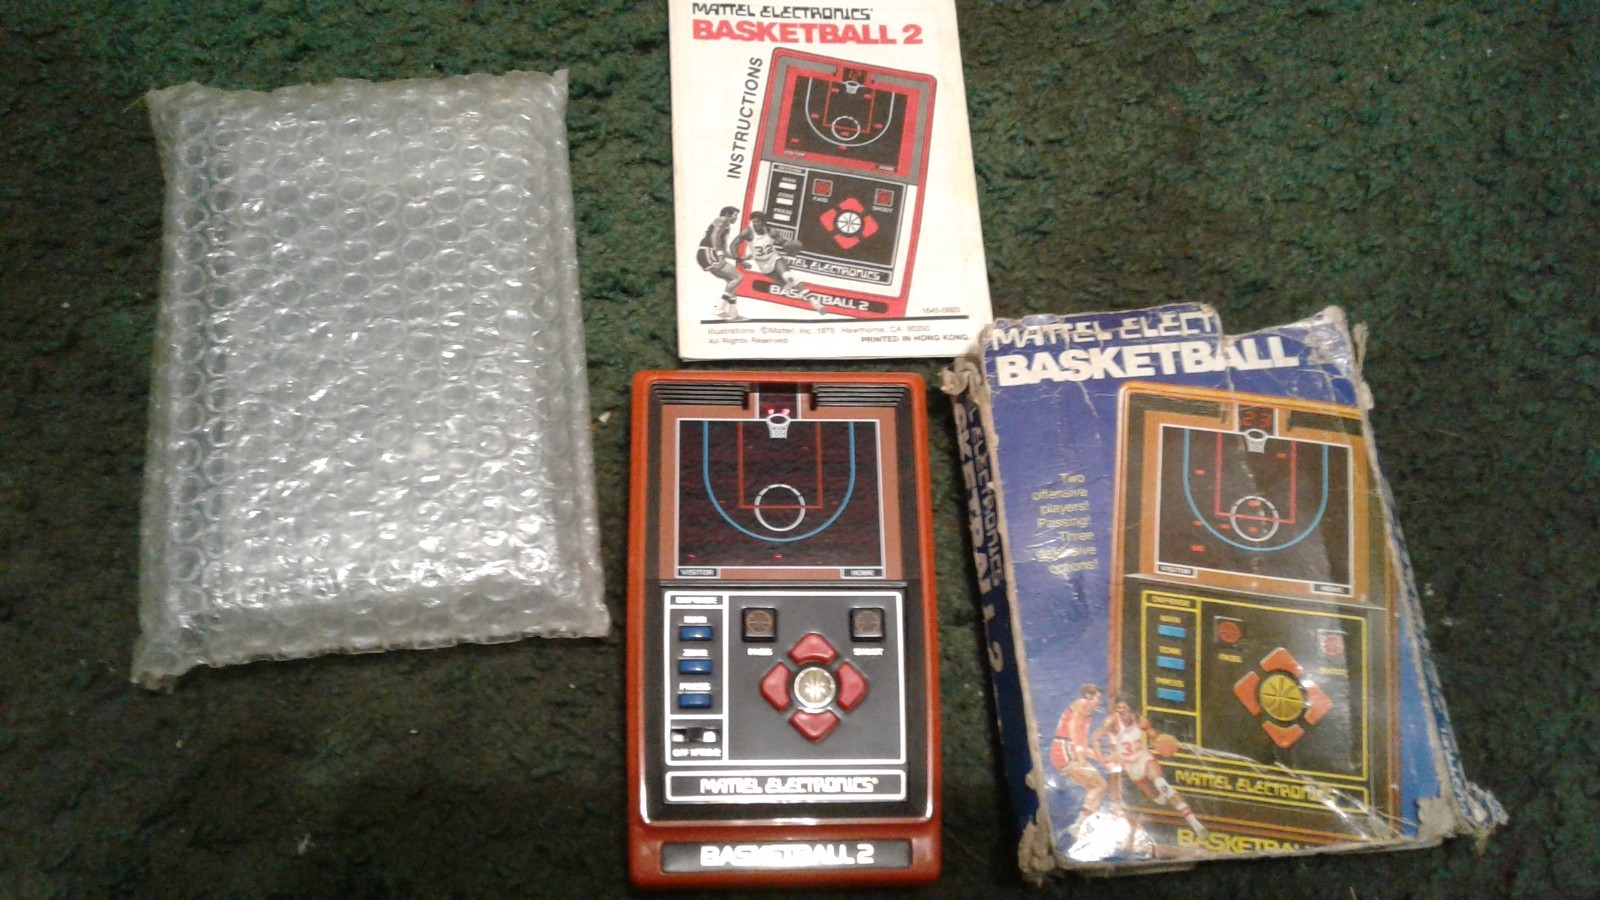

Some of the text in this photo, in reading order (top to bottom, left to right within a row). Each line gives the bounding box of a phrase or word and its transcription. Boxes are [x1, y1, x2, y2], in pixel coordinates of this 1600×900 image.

[692, 3, 871, 20] MATTEL ELECTRONICS
[692, 19, 923, 44] BASKETBALL 2
[727, 57, 763, 179] INSTRUCTIONS
[754, 244, 773, 256] 32
[810, 261, 880, 281] ELECTRONICS
[858, 301, 870, 311] 2
[708, 327, 755, 335] Illustrations
[991, 311, 1216, 350] MATTEL ELECT
[722, 337, 748, 346] Rights
[751, 336, 788, 344] Reserved
[861, 335, 899, 343] PRINTED
[914, 334, 940, 342] HONG
[996, 335, 1300, 387] BASKETBALL
[1242, 410, 1271, 428] 23
[1057, 472, 1086, 484] Two
[1031, 488, 1089, 501] offensive
[1039, 501, 1091, 515] players!
[1036, 515, 1092, 529] Passing!
[1058, 531, 1096, 542] Three
[700, 776, 875, 794] MATTEL ELECTRONICS
[1174, 769, 1233, 791] MATTEL
[700, 843, 876, 867] BASKETBALL 2
